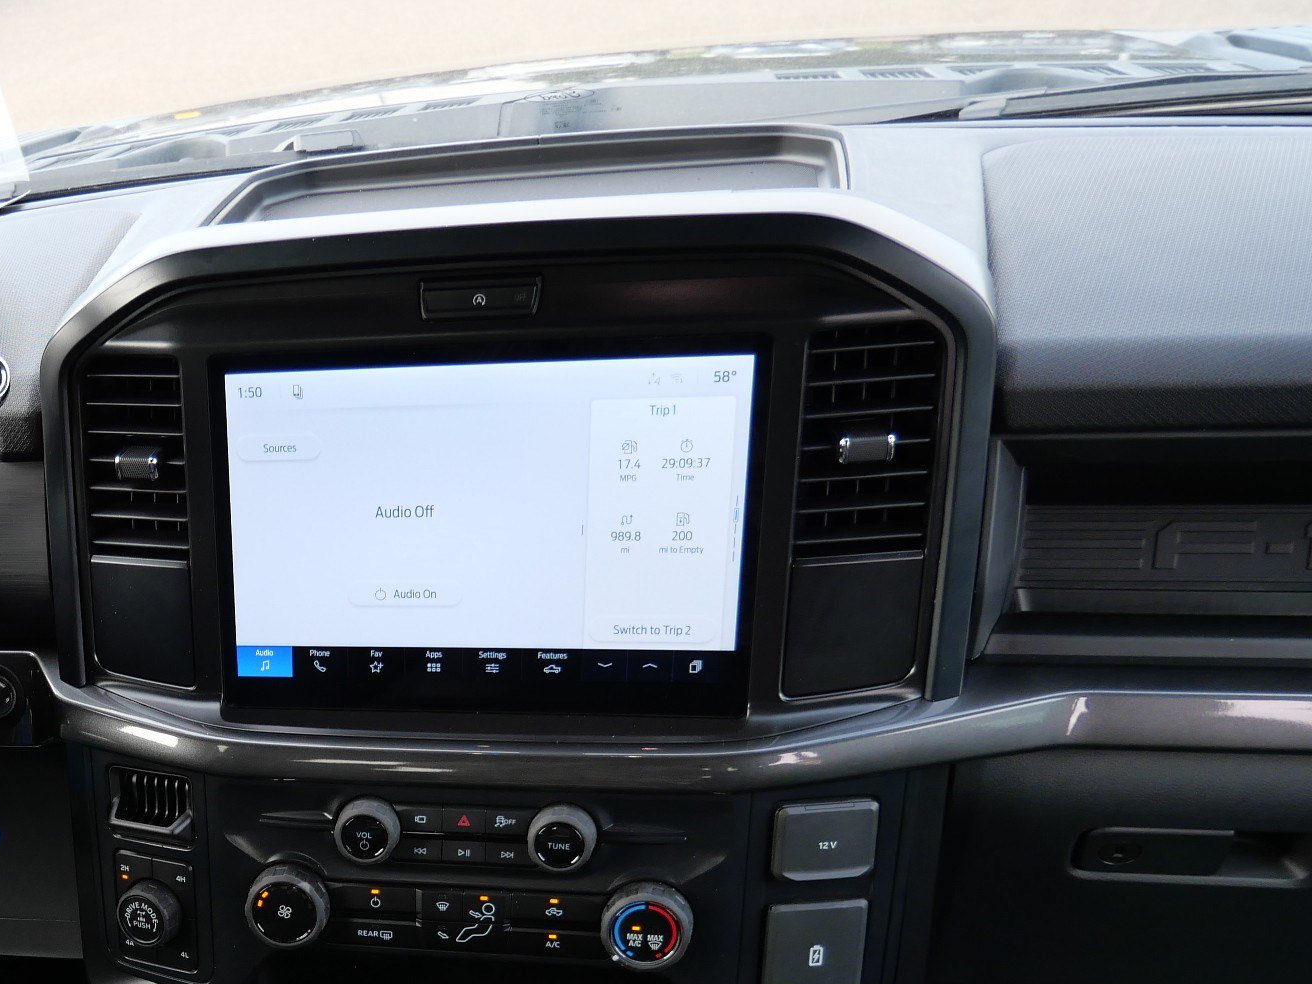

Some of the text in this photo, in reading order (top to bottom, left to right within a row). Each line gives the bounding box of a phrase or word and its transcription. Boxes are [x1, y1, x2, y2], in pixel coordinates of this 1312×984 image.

[713, 370, 737, 383] 58°
[238, 386, 263, 399] 1:50
[650, 404, 670, 417] Trip
[263, 443, 297, 454] Sources
[618, 458, 711, 469] 17.4 29:09:37
[619, 474, 695, 482] MPG Time
[375, 505, 435, 519] Audio Off
[610, 530, 693, 542] 989.8 200
[620, 546, 630, 554] mi
[659, 546, 668, 554] mi
[679, 546, 704, 555] Empty
[393, 589, 437, 599] Audio On
[613, 624, 691, 637] Switch to Trip 2
[255, 648, 274, 657] Audio
[309, 649, 331, 657] Phone
[370, 649, 383, 658] Fav
[425, 650, 443, 659] Apps
[478, 650, 507, 660] Settings
[537, 651, 568, 660] Features
[504, 817, 516, 826] OFF
[356, 831, 373, 840] VOL
[547, 842, 570, 851] TUNE
[818, 841, 829, 850] 12
[120, 864, 130, 872] 2H
[175, 875, 186, 883] 4H
[124, 901, 159, 924] DRIVE MODE
[133, 920, 151, 930] PUSH
[357, 929, 379, 938] REAR
[626, 933, 643, 942] MAX
[125, 939, 135, 947] 4A
[647, 934, 664, 943] MAX
[545, 941, 560, 949] A/C
[628, 940, 642, 948] A/C
[180, 951, 189, 959] 4L
